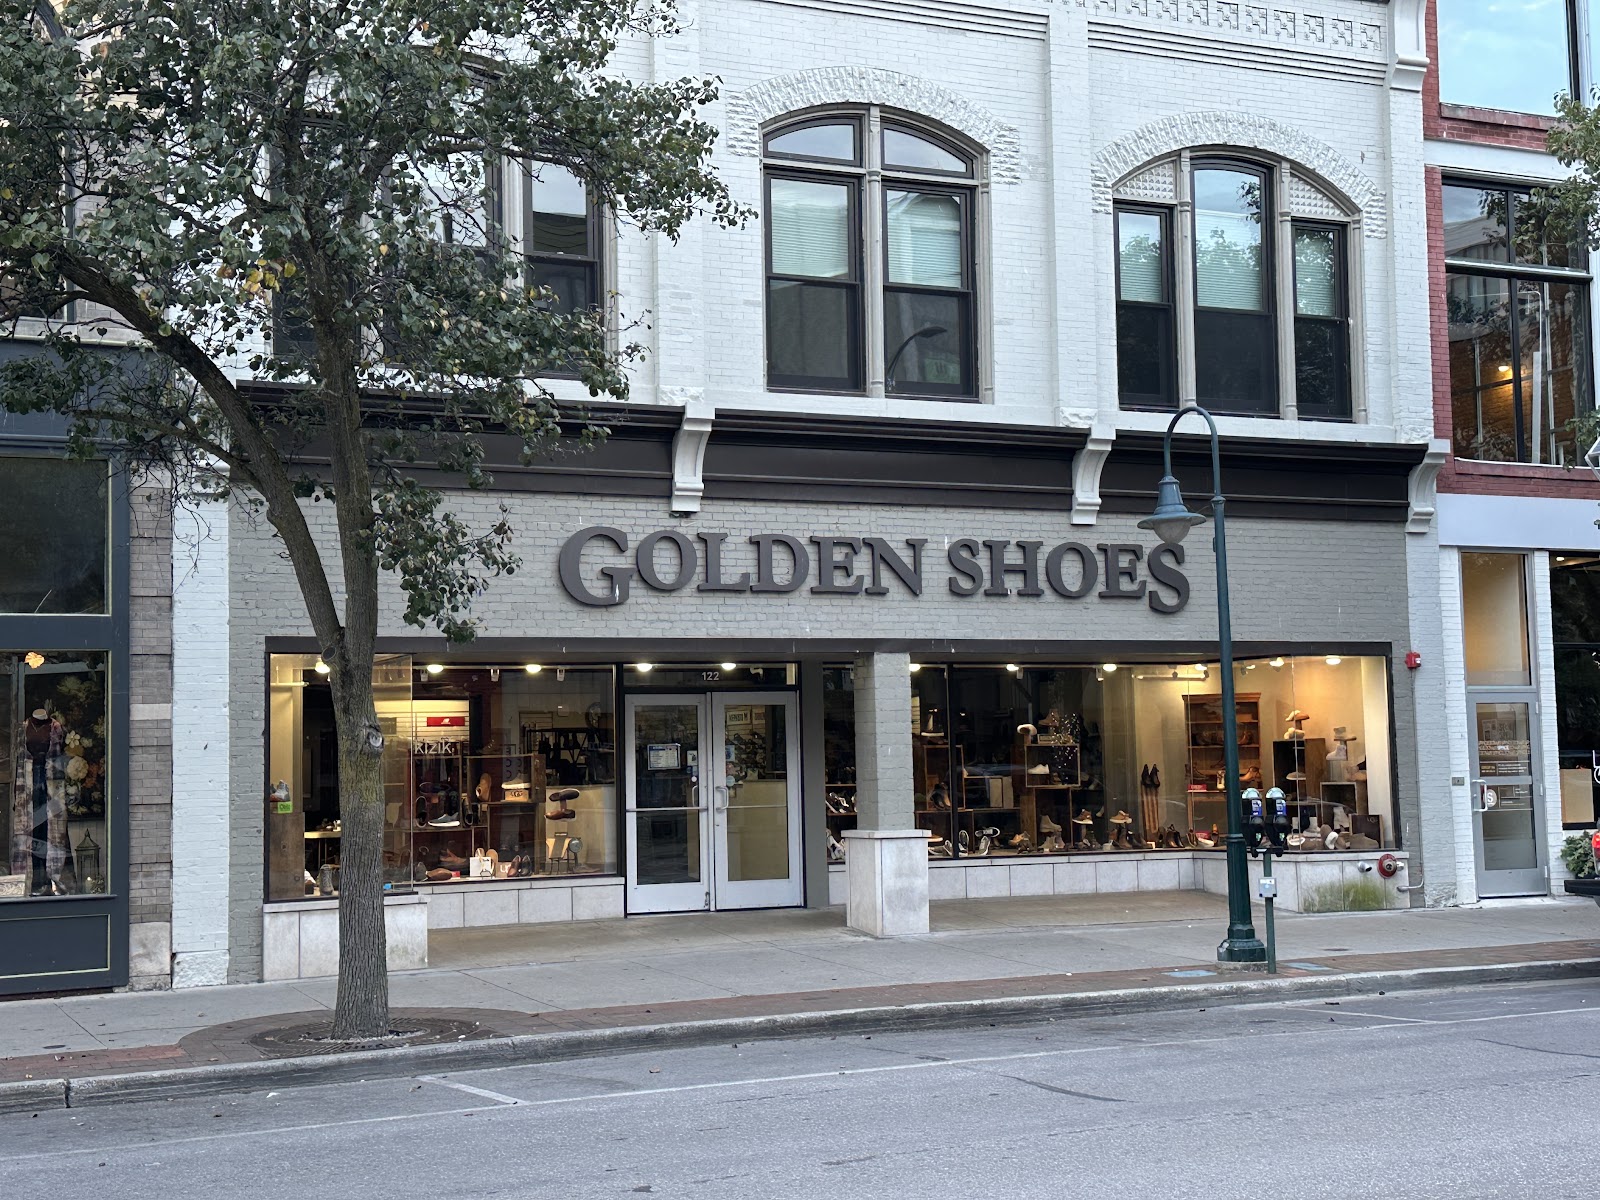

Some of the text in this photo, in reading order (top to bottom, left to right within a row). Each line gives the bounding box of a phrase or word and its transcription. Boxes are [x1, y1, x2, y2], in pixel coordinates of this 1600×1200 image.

[559, 525, 1190, 613] GOLDEN SHOES
[702, 671, 720, 681] 122
